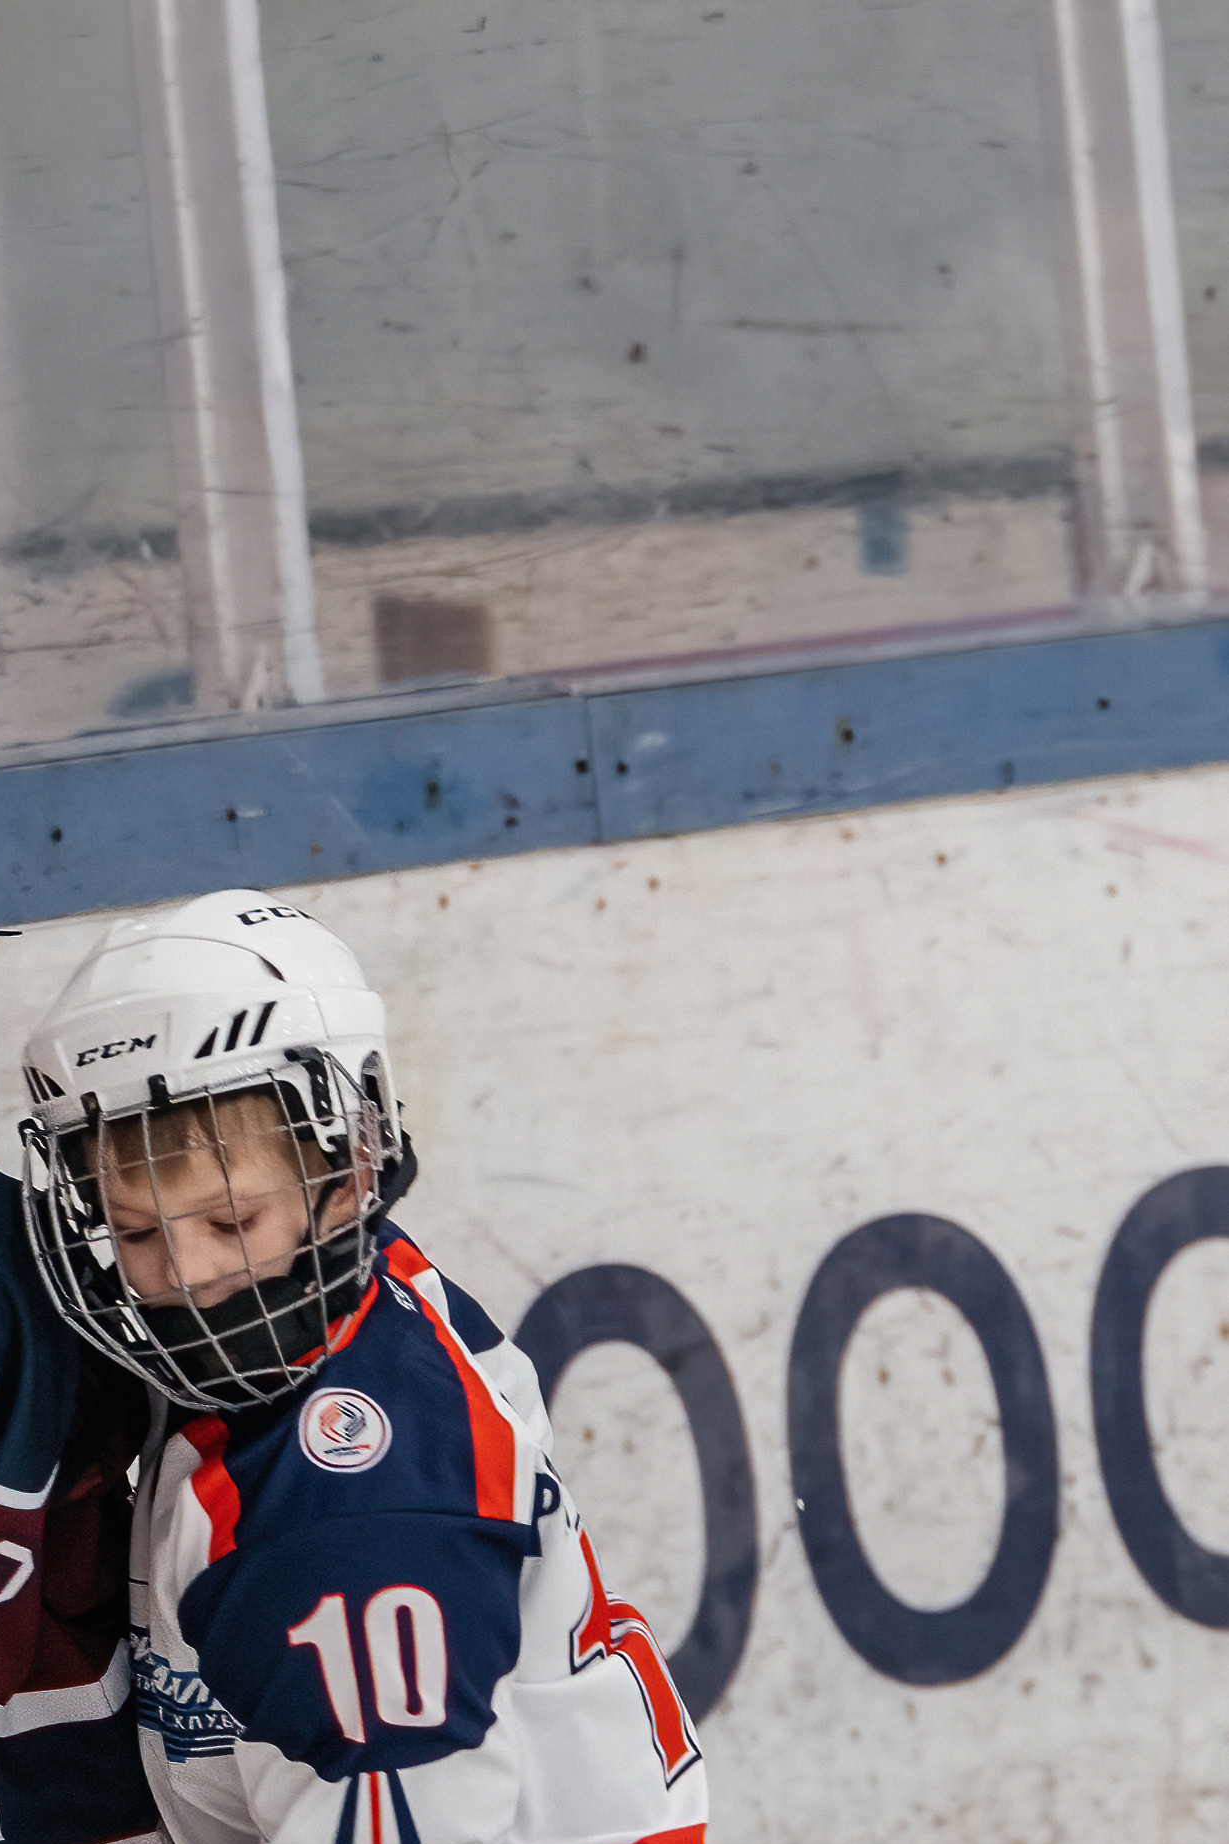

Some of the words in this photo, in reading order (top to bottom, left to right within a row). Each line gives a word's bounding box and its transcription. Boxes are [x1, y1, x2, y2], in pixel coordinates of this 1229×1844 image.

[235, 906, 310, 926] CC
[75, 1034, 157, 1067] CCM
[288, 1583, 448, 1744] 10
